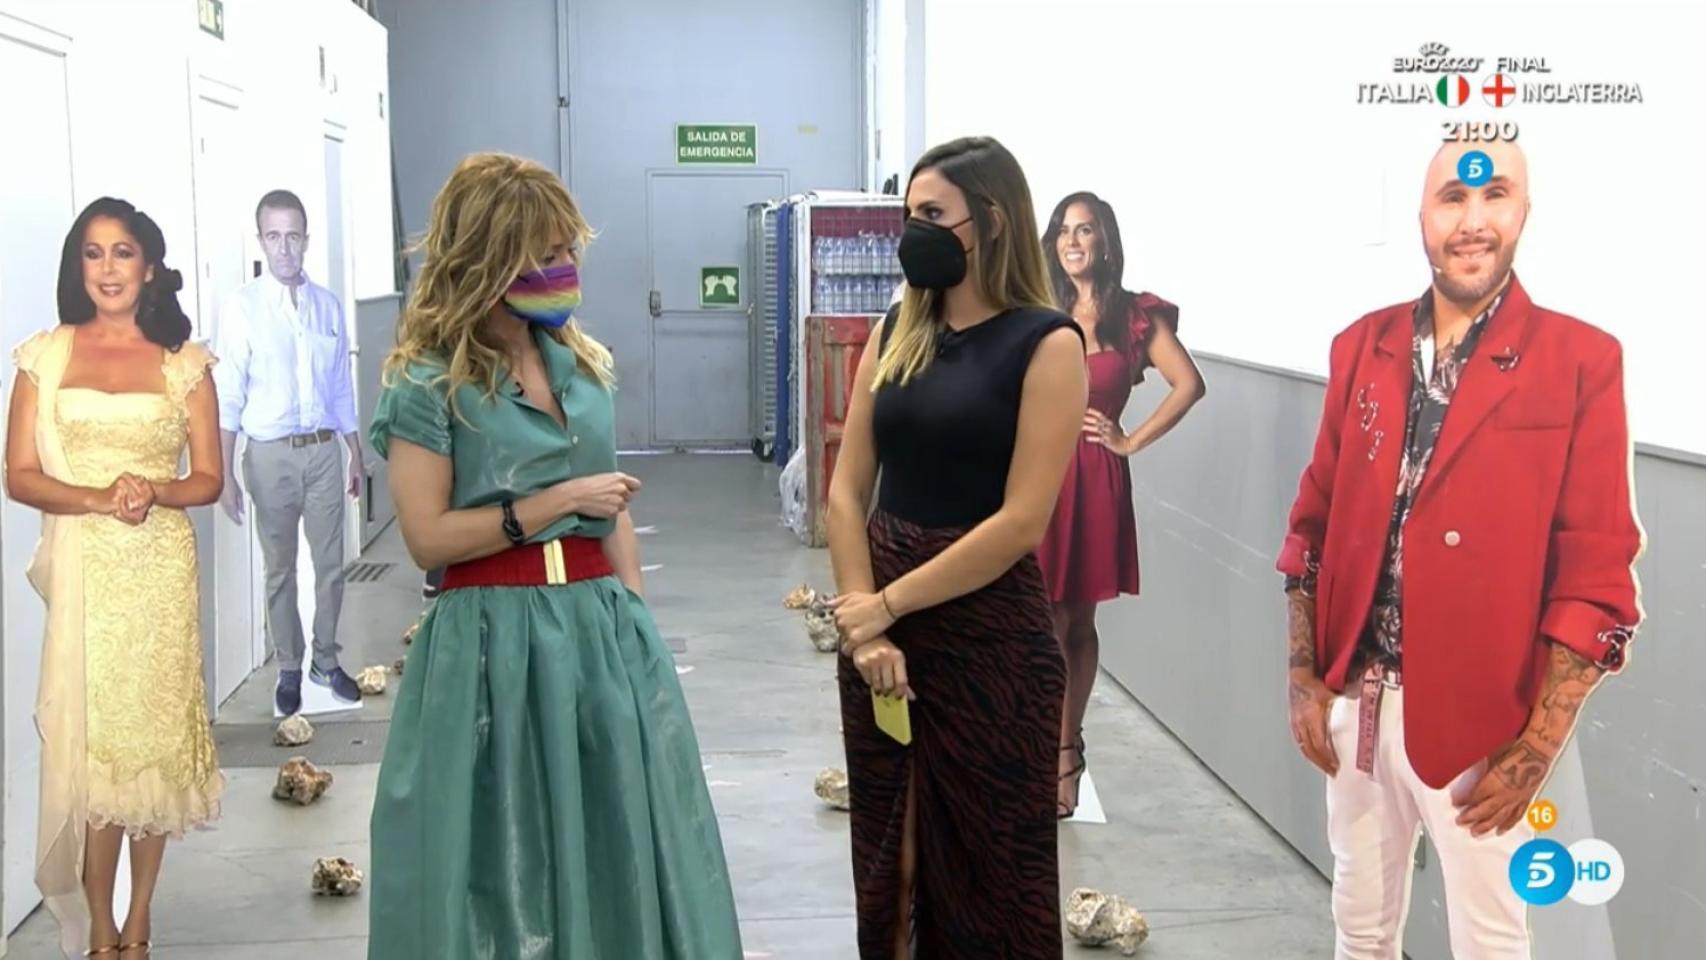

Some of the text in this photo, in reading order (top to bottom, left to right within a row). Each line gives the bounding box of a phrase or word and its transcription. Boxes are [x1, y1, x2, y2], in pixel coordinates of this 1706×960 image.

[687, 131, 747, 142] SALIDA DE
[679, 146, 754, 157] EMERGENCIA
